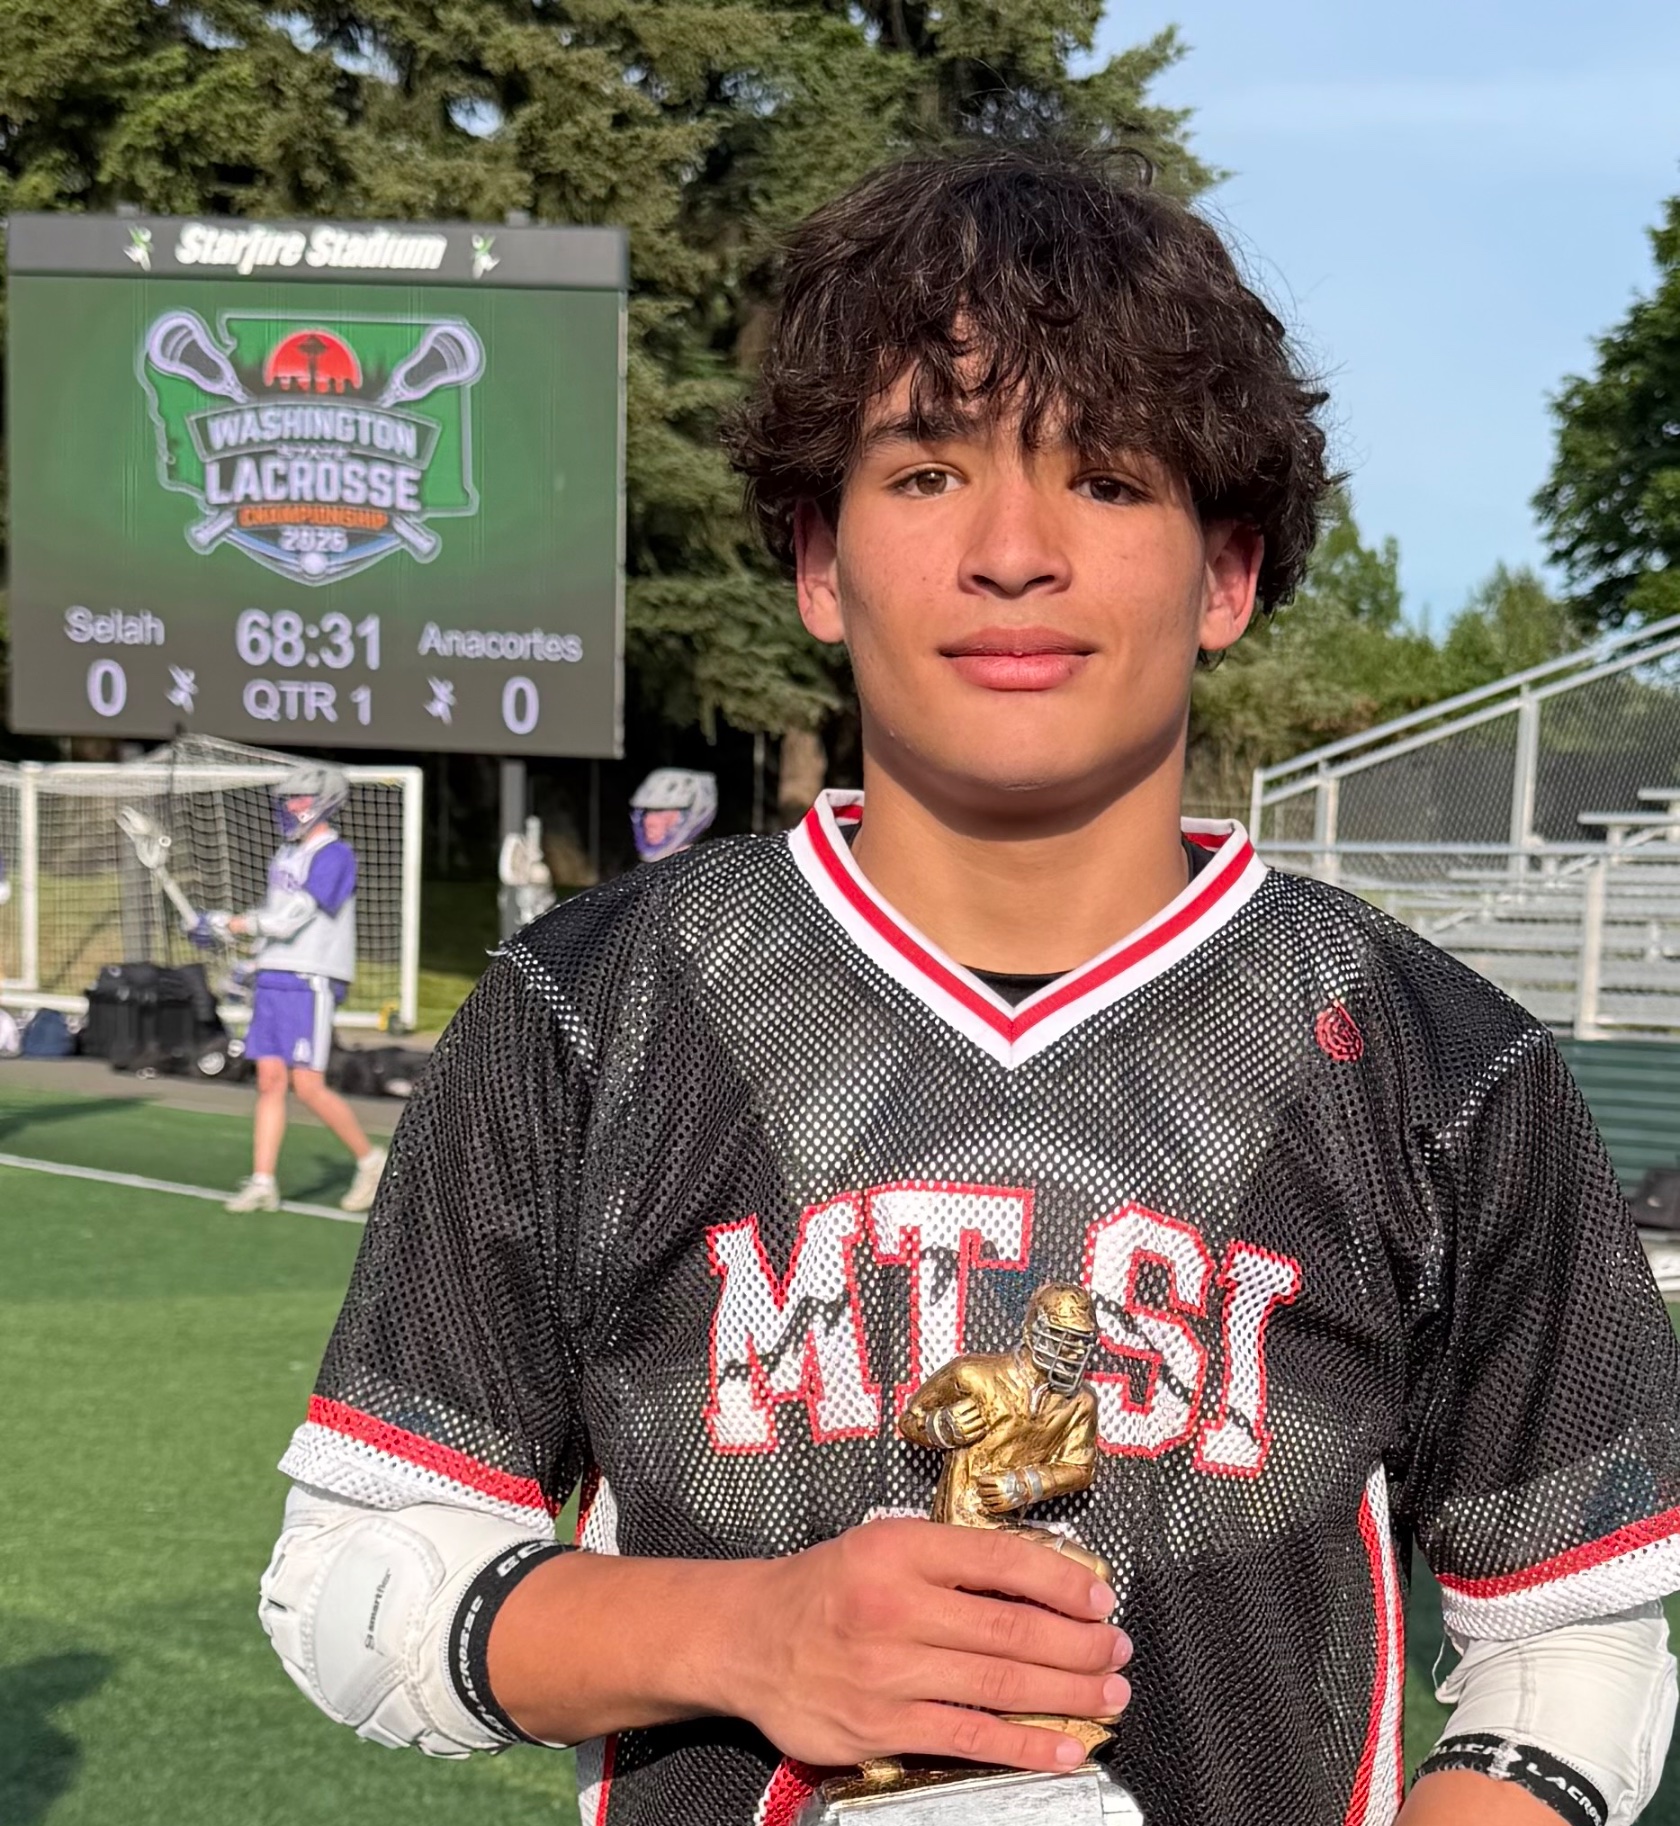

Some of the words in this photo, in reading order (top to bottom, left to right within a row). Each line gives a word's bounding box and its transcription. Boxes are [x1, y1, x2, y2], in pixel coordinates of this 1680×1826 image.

[175, 223, 306, 275] Starfire
[305, 225, 447, 269] Stadium
[207, 407, 417, 459] WASHINGTON
[205, 457, 422, 512] LACROSSE
[64, 606, 165, 646] Selah
[236, 608, 381, 671] 68:31
[418, 621, 584, 663] Anacortes
[86, 658, 128, 717] 0
[243, 677, 338, 723] QTR
[350, 684, 372, 725] 1
[502, 675, 540, 735] 0
[702, 1178, 1035, 1456] MT
[1086, 1201, 1304, 1479] SI
